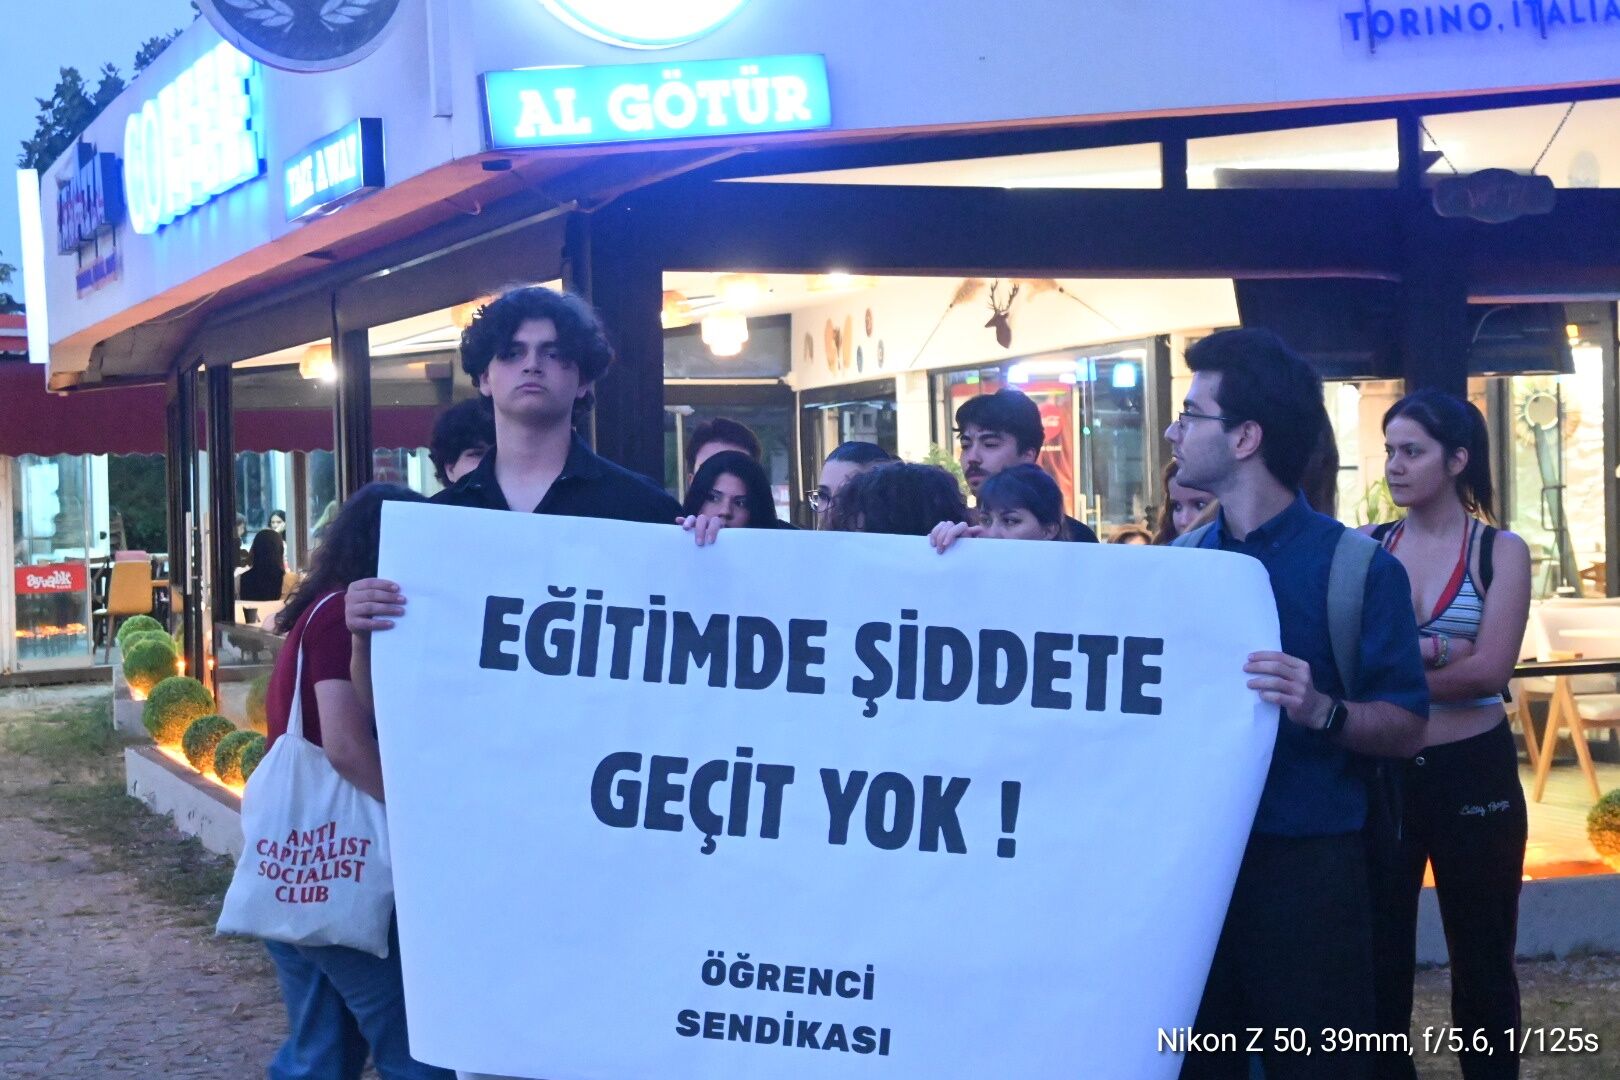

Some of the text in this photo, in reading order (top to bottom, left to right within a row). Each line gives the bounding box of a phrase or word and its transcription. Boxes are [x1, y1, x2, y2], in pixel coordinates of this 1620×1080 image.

[1512, 0, 1620, 28] ITALIA
[514, 64, 813, 138] AL GÖTÜR
[479, 585, 1164, 718] EĞİTİMDE ŞİDDETE
[591, 746, 1021, 858] GEÇİT YOK !
[256, 837, 371, 866] CAPITALIST
[286, 821, 337, 848] ANTI
[258, 860, 365, 884] SOCIALIST
[275, 885, 330, 904] CLUB
[701, 949, 875, 1000] ÖĞRENCİ
[675, 1009, 891, 1056] SENDİKASI
